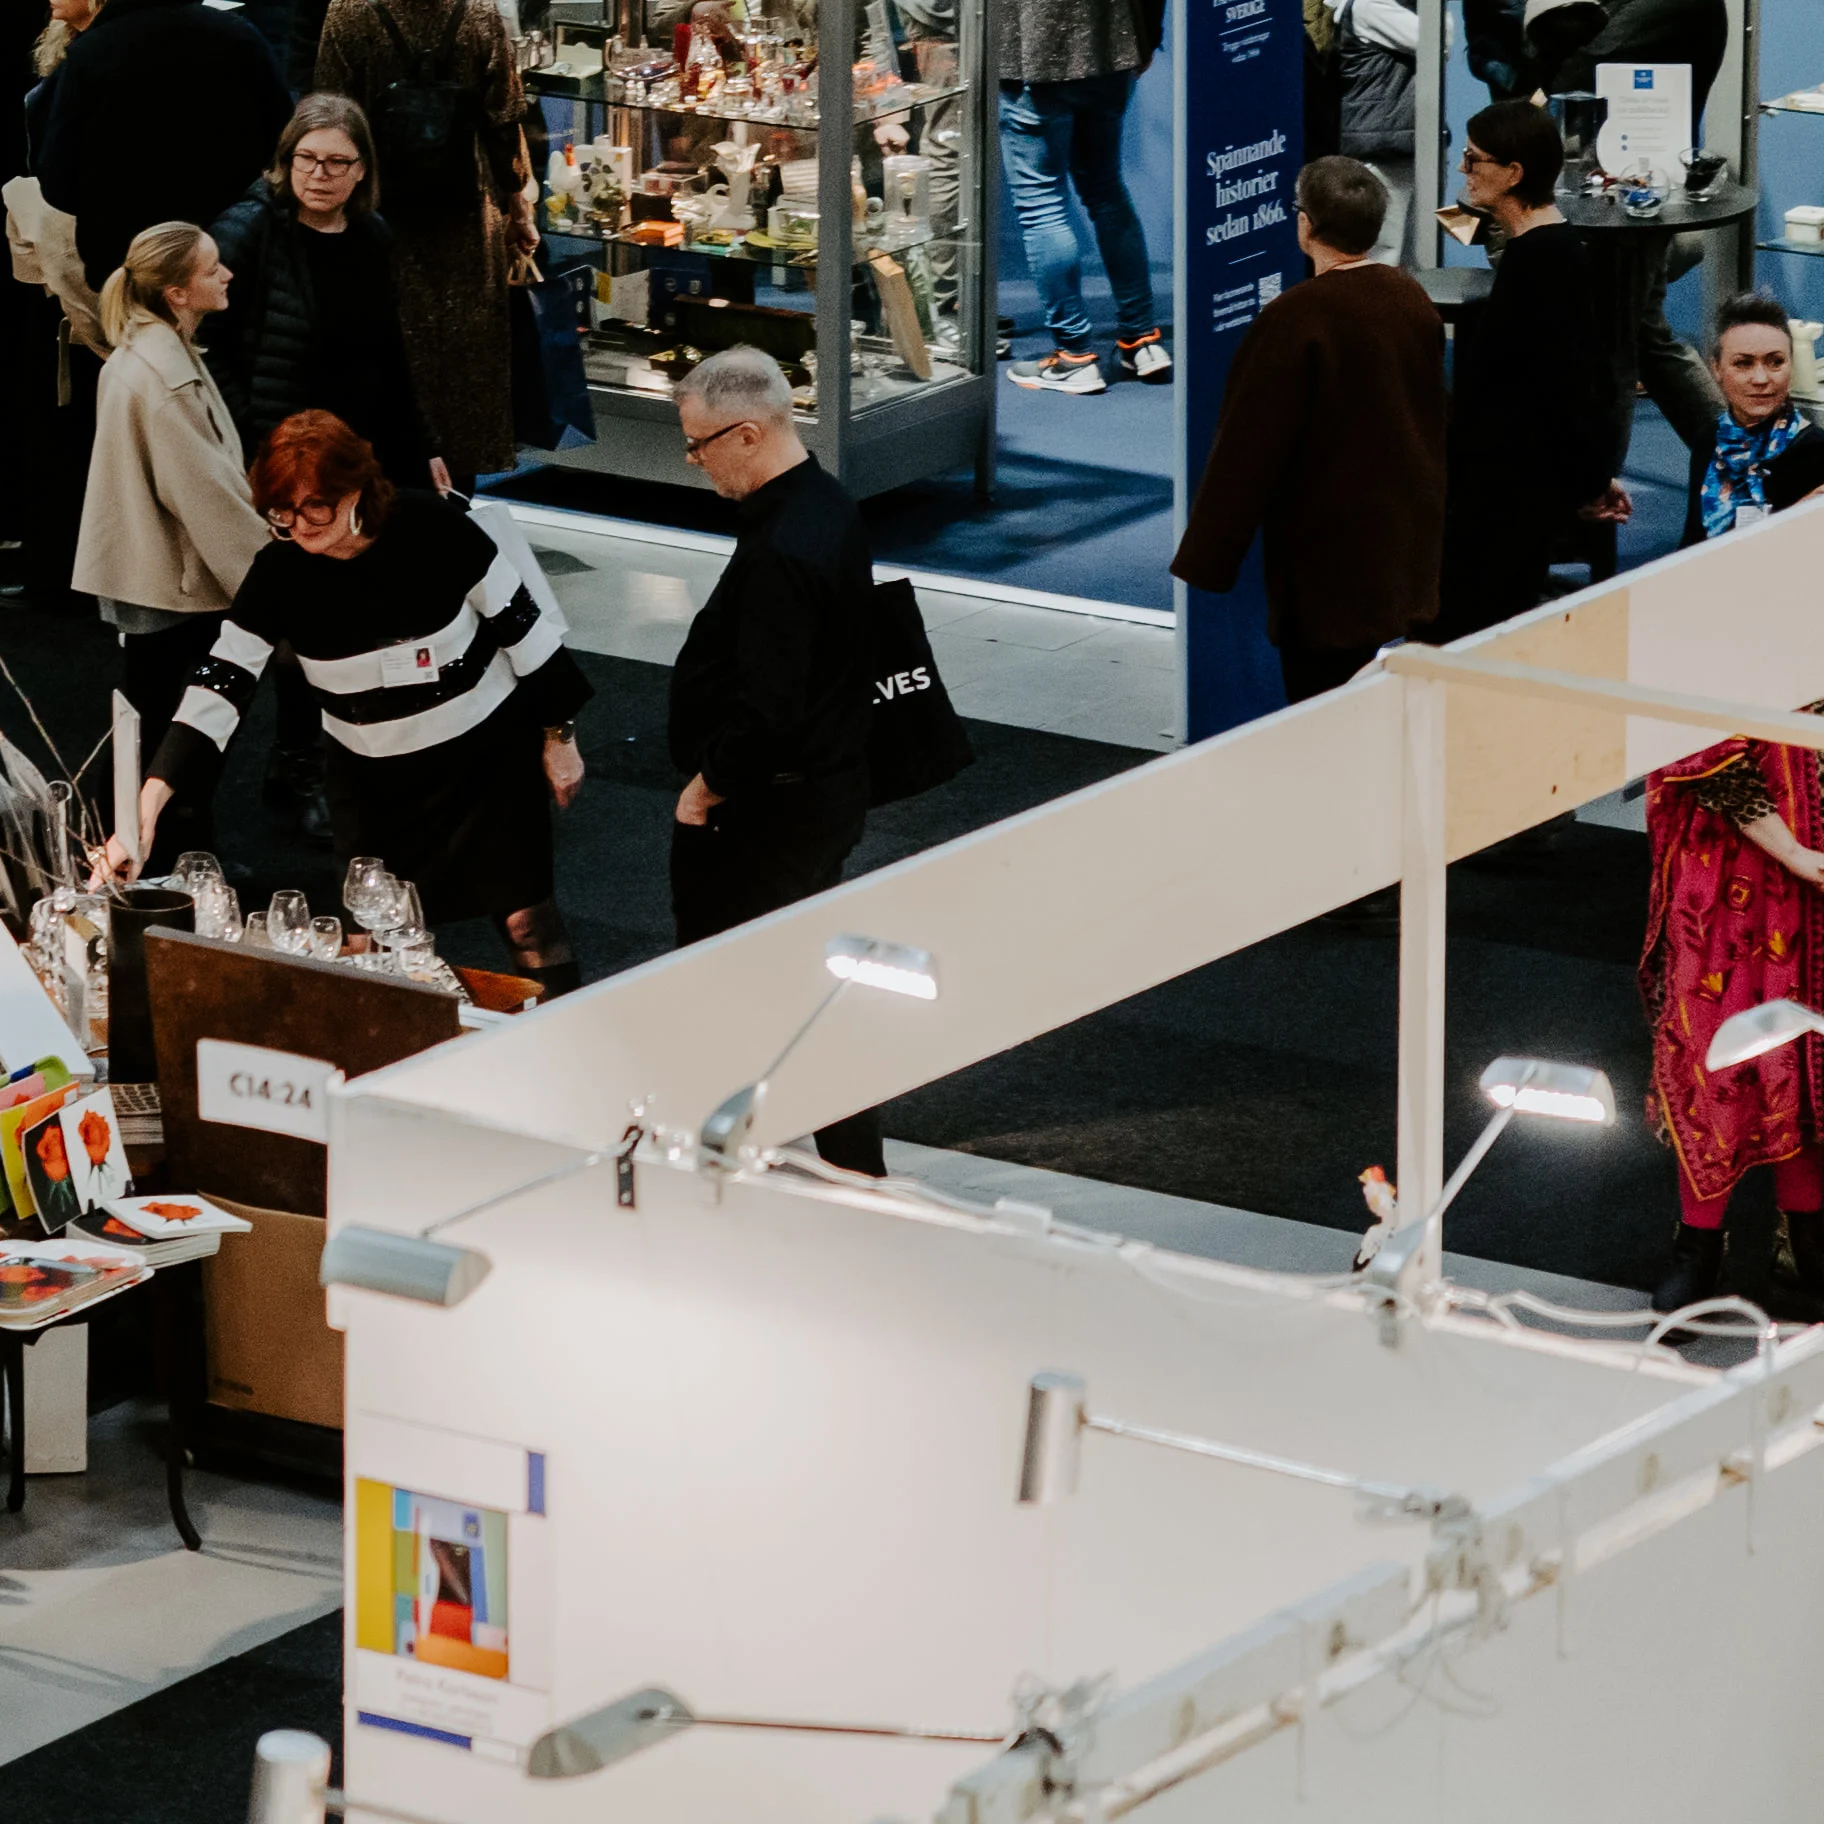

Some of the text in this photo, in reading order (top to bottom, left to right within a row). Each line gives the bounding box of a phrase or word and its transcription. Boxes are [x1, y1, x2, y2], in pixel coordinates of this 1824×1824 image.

[1206, 128, 1287, 180] Spännande
[1215, 168, 1280, 208] historier
[1205, 213, 1250, 246] sedan
[872, 665, 932, 706] VES
[229, 1071, 313, 1111] C14:24
